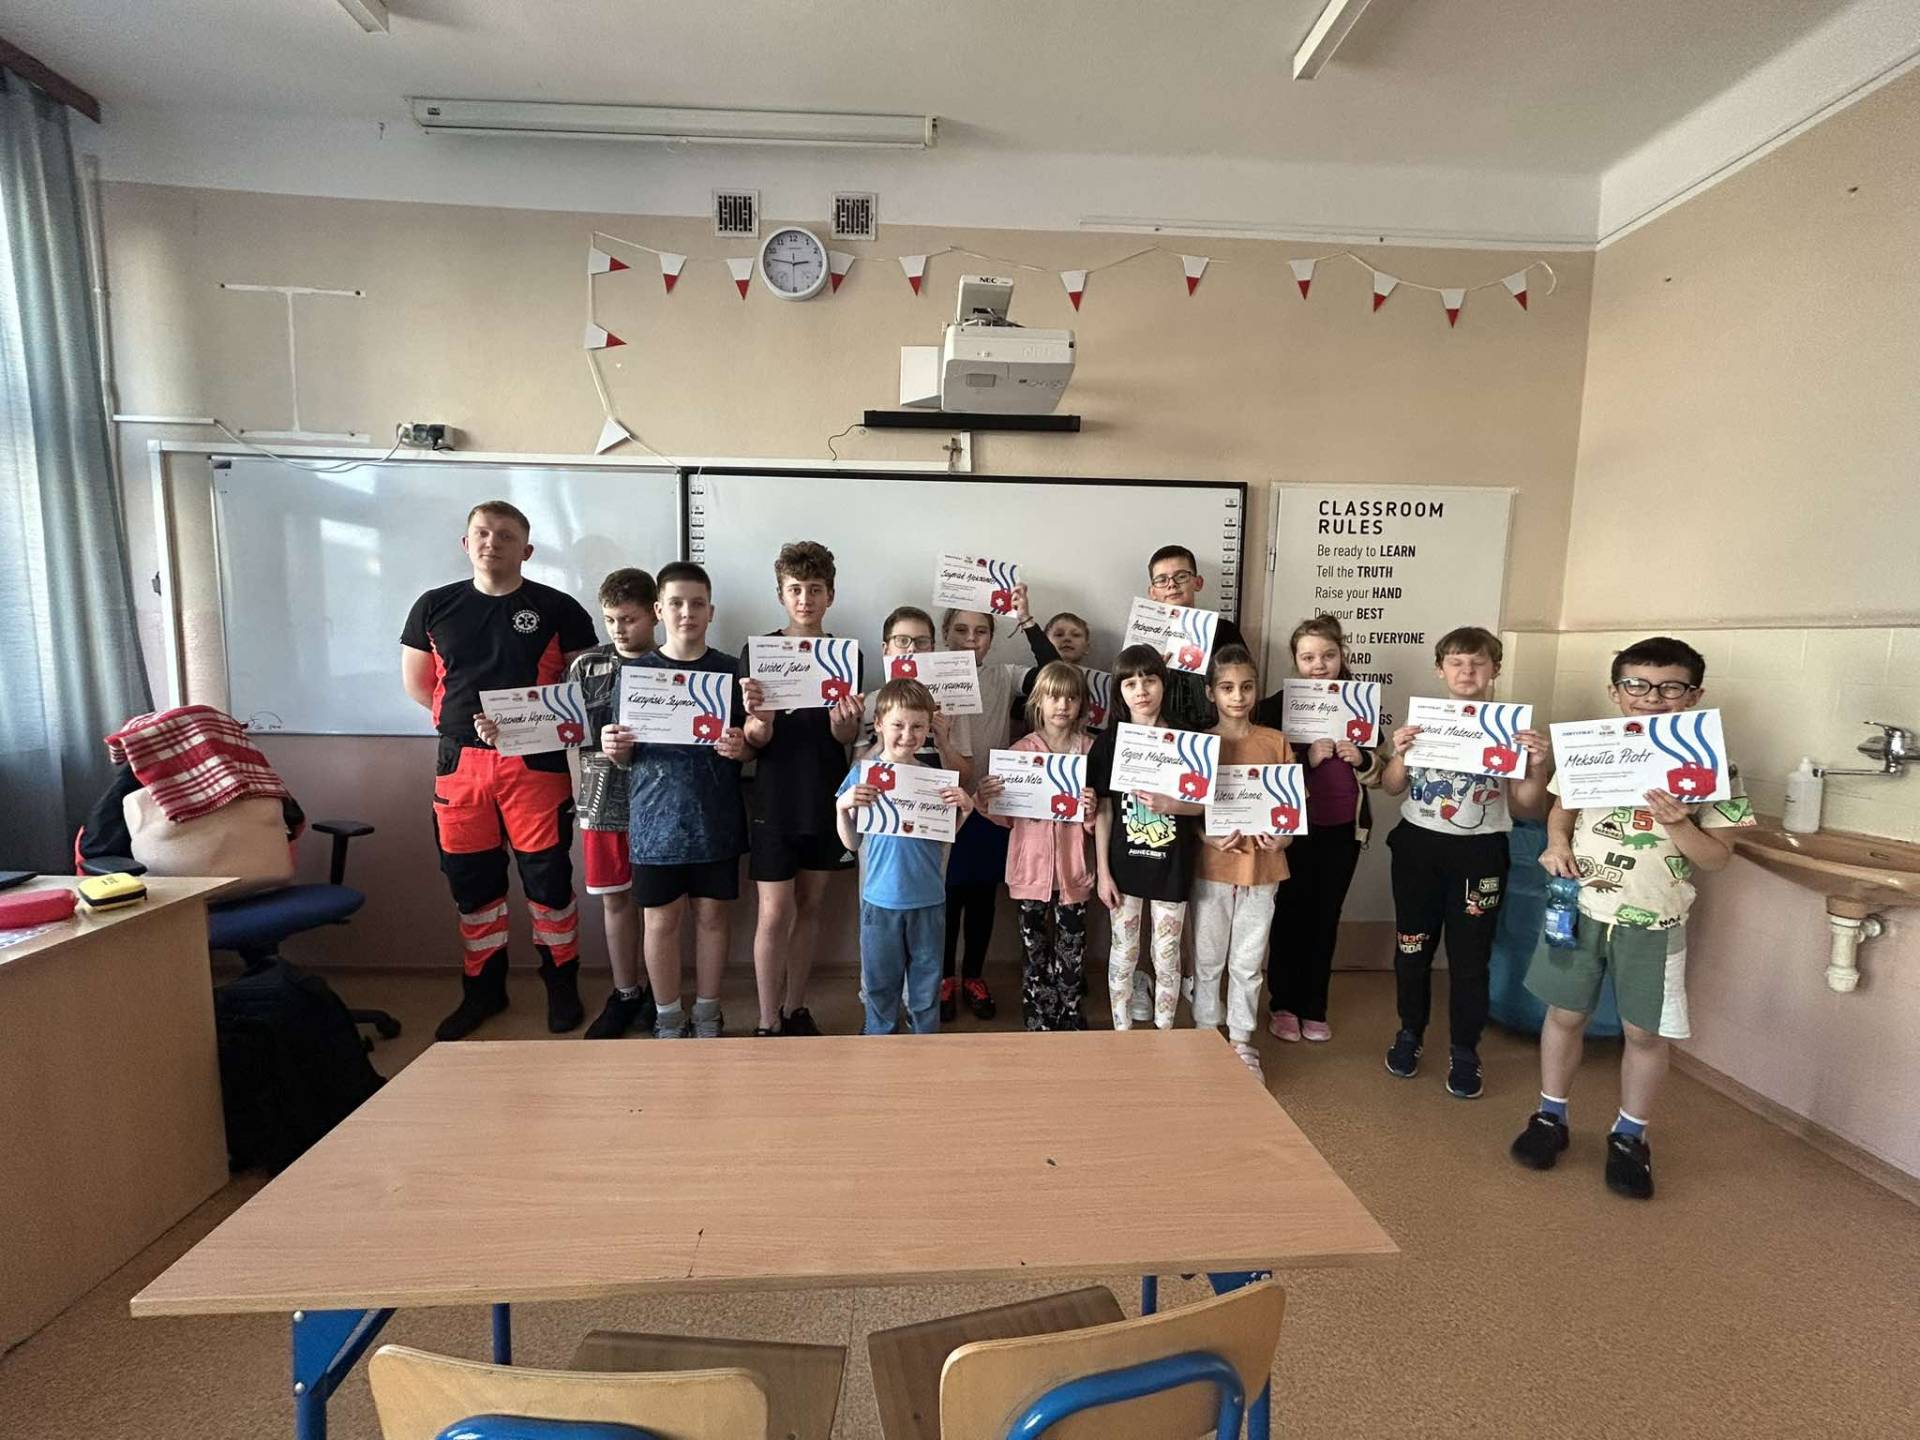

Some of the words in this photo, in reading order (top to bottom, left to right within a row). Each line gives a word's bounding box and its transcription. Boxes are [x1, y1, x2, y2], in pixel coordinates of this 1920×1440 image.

[1319, 500, 1444, 517] CLASSROOM
[1318, 519, 1383, 535] RULES
[1317, 544, 1331, 557] Be
[1334, 545, 1363, 560] ready
[1366, 546, 1377, 557] to
[1380, 545, 1416, 557] LEARN
[1317, 565, 1334, 578] Tell
[1337, 565, 1354, 578] the
[1357, 566, 1393, 578] TRUTH
[1315, 586, 1344, 599] Raise
[1346, 588, 1369, 601] your
[1372, 587, 1402, 599] HAND
[1356, 608, 1384, 620] BEST
[1356, 633, 1366, 644] to
[1369, 632, 1425, 644] EVERYONE
[1443, 726, 1483, 739] Mateusz
[1618, 748, 1655, 766] Piotr
[1632, 809, 1654, 831] 5
